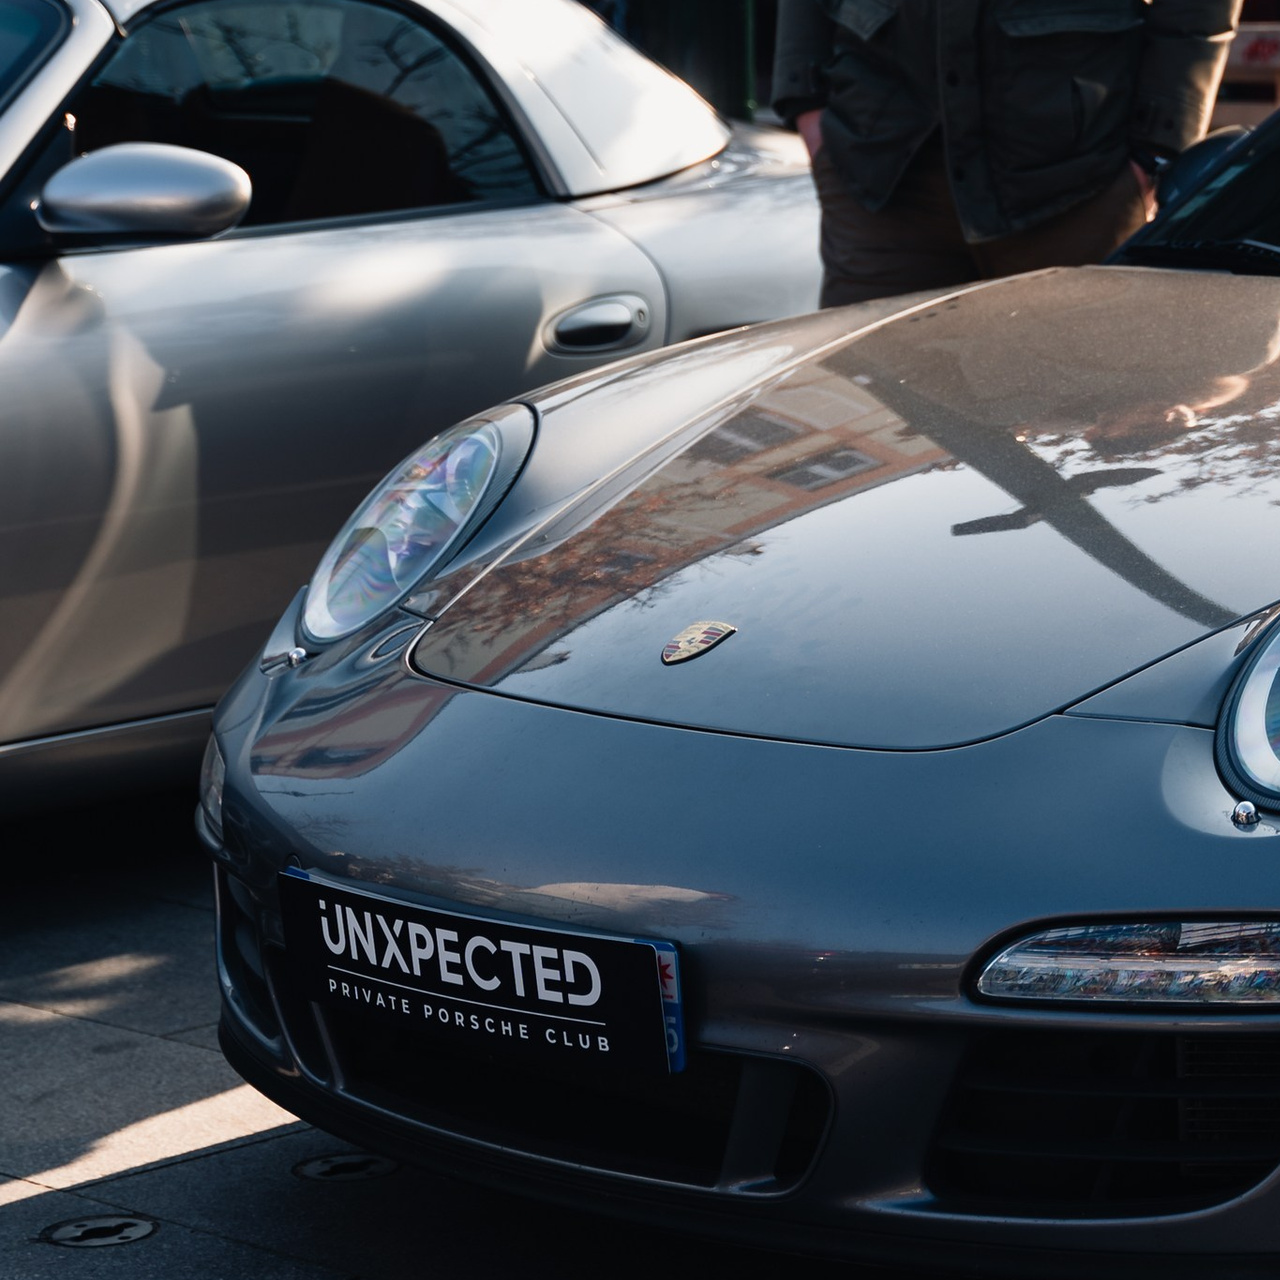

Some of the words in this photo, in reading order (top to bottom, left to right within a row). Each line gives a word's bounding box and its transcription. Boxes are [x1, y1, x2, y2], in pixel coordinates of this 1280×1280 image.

[319, 899, 602, 1007] UNXPECTED
[328, 978, 412, 1015] PRIVATE
[423, 1003, 530, 1040] PORSCHE
[545, 1028, 611, 1052] CLUB
